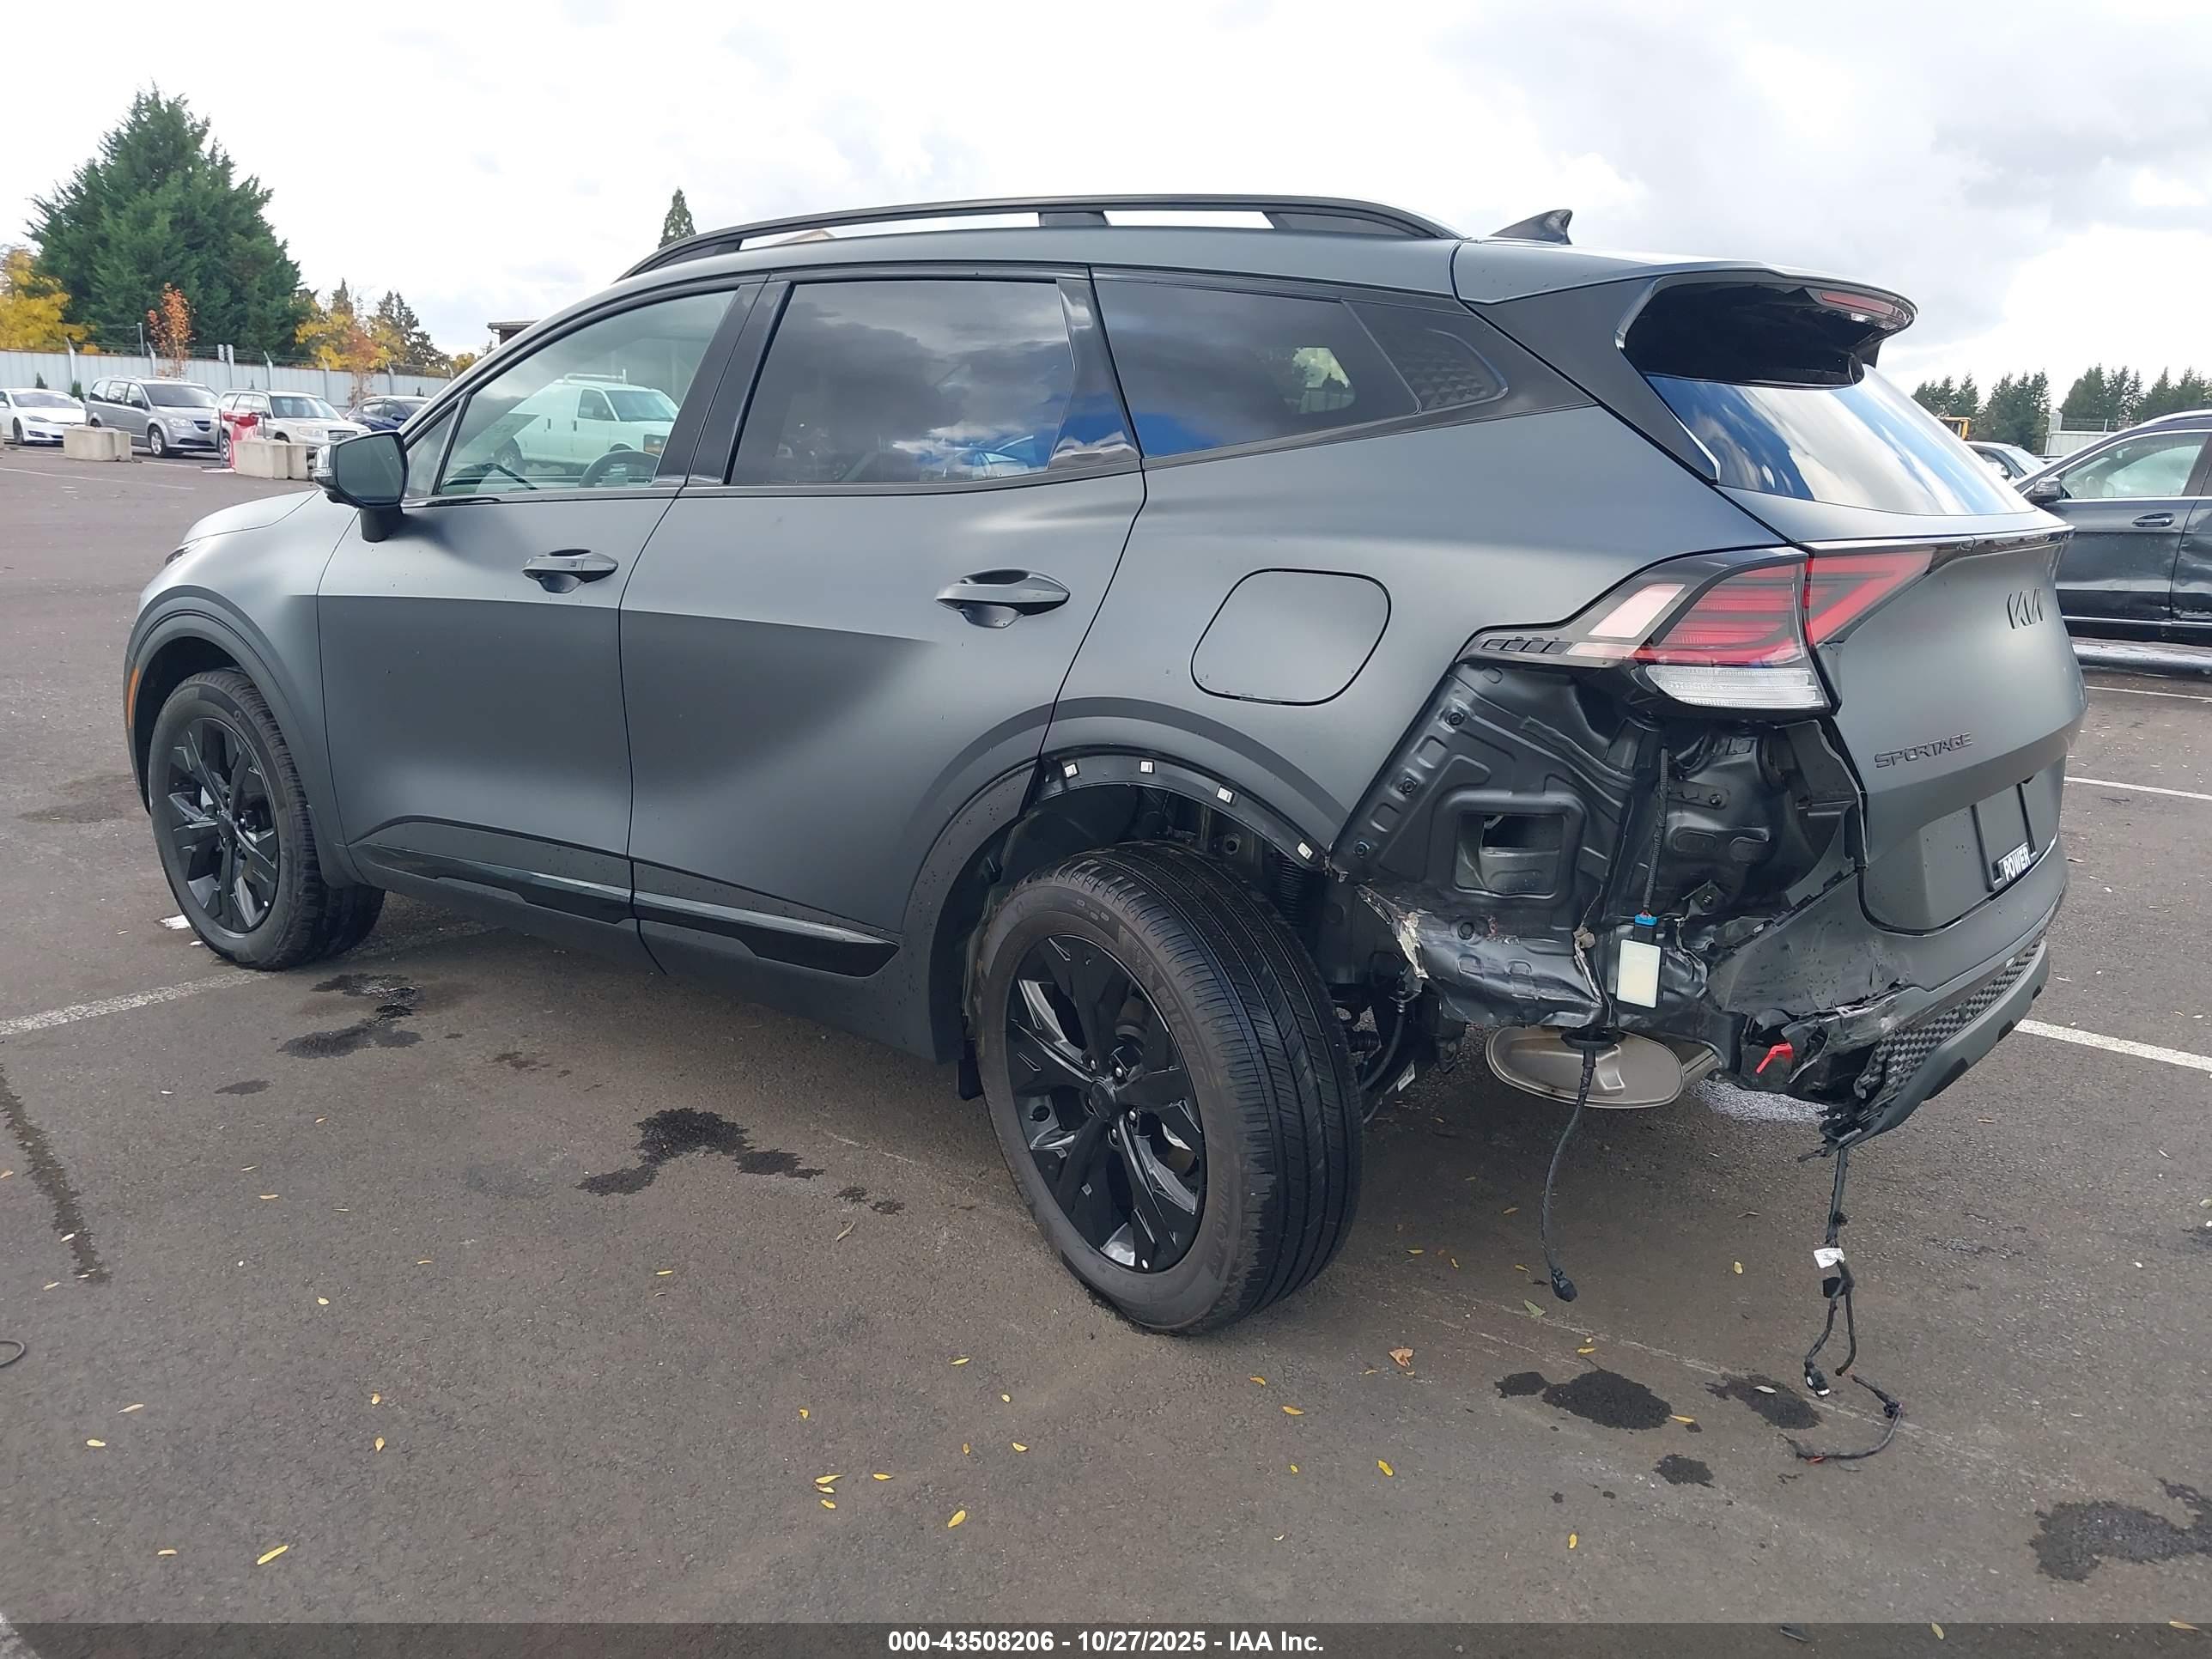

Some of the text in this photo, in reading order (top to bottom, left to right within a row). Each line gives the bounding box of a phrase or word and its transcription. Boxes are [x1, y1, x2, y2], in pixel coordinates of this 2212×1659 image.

[2007, 587, 2044, 629] KIA
[1875, 732, 1972, 769] SPORTAGE
[2002, 846, 2032, 882] POWER
